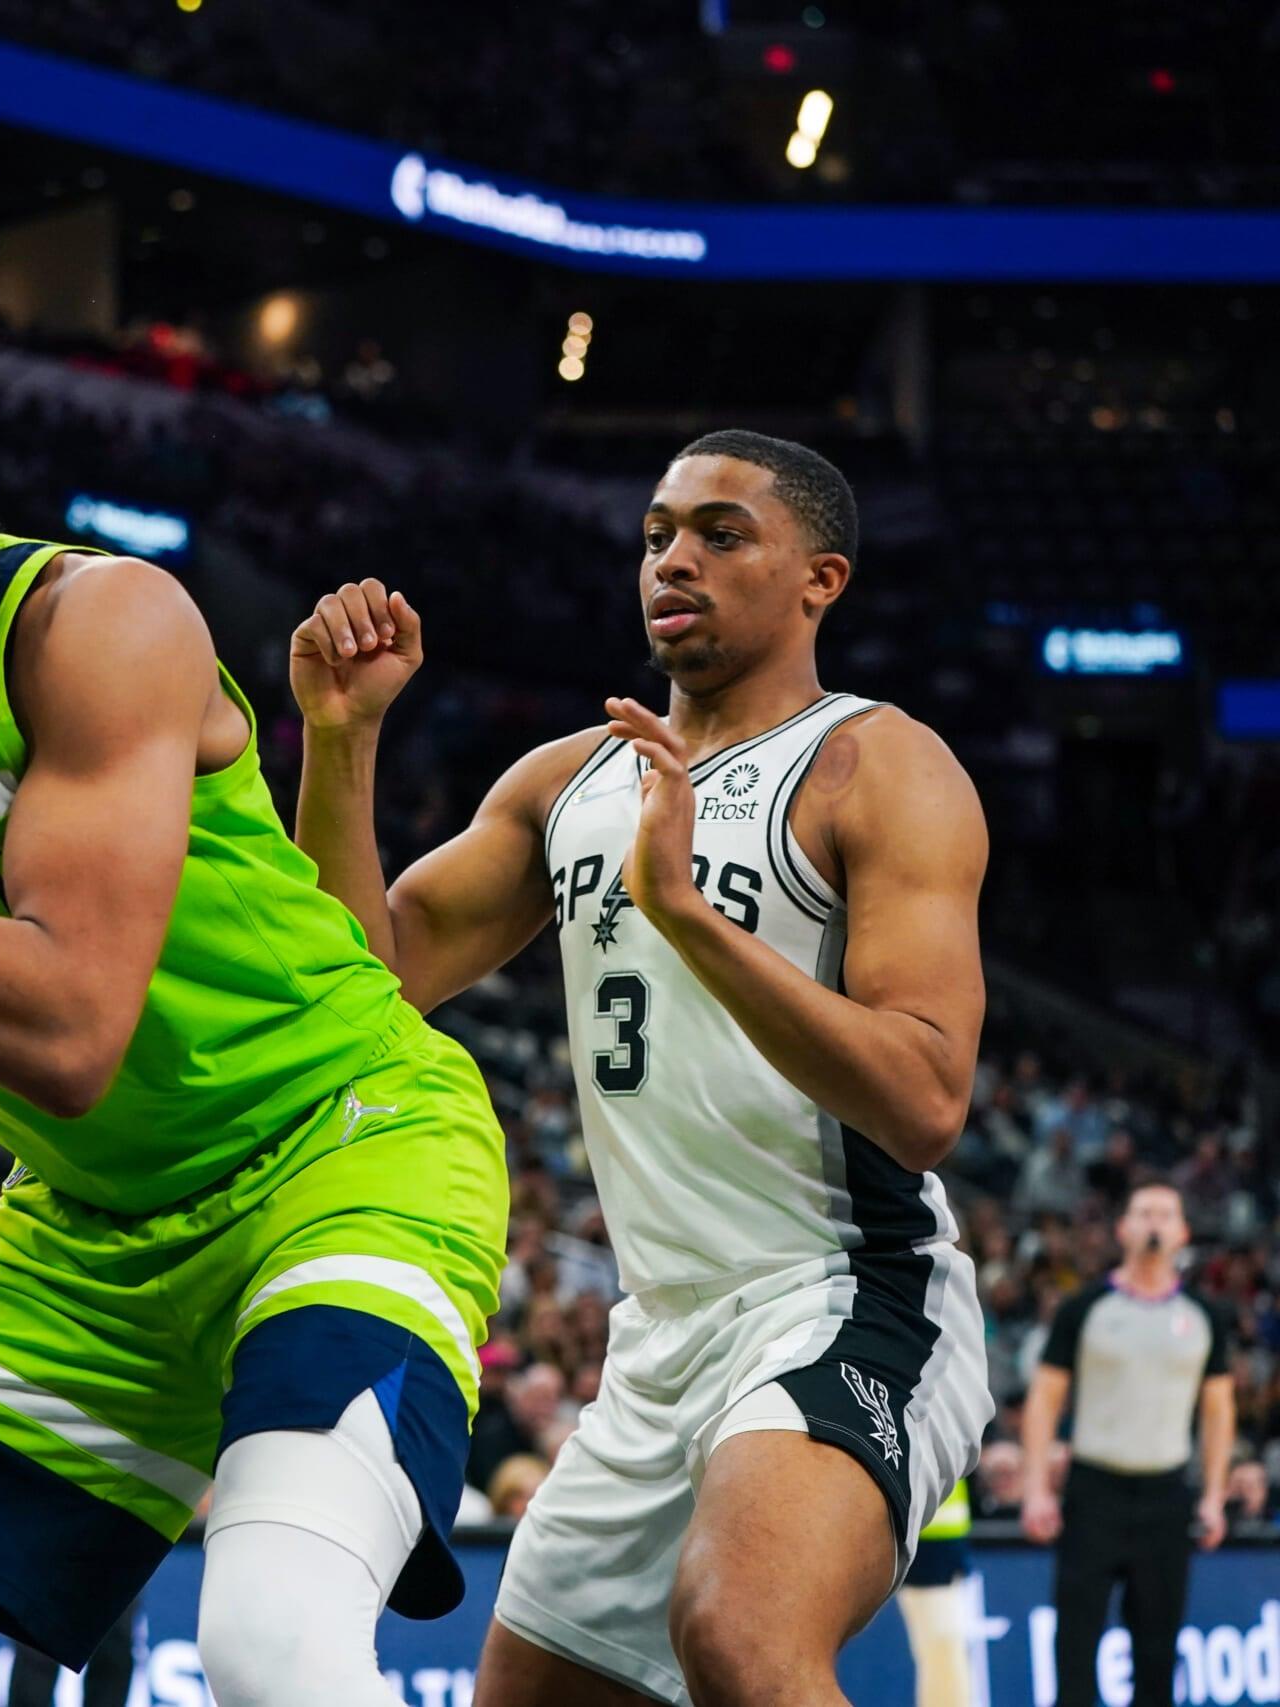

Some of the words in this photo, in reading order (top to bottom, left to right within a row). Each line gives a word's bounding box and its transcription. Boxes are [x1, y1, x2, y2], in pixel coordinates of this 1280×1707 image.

[698, 797, 759, 820] Frost
[552, 853, 763, 936] SPS
[593, 971, 651, 1097] 3
